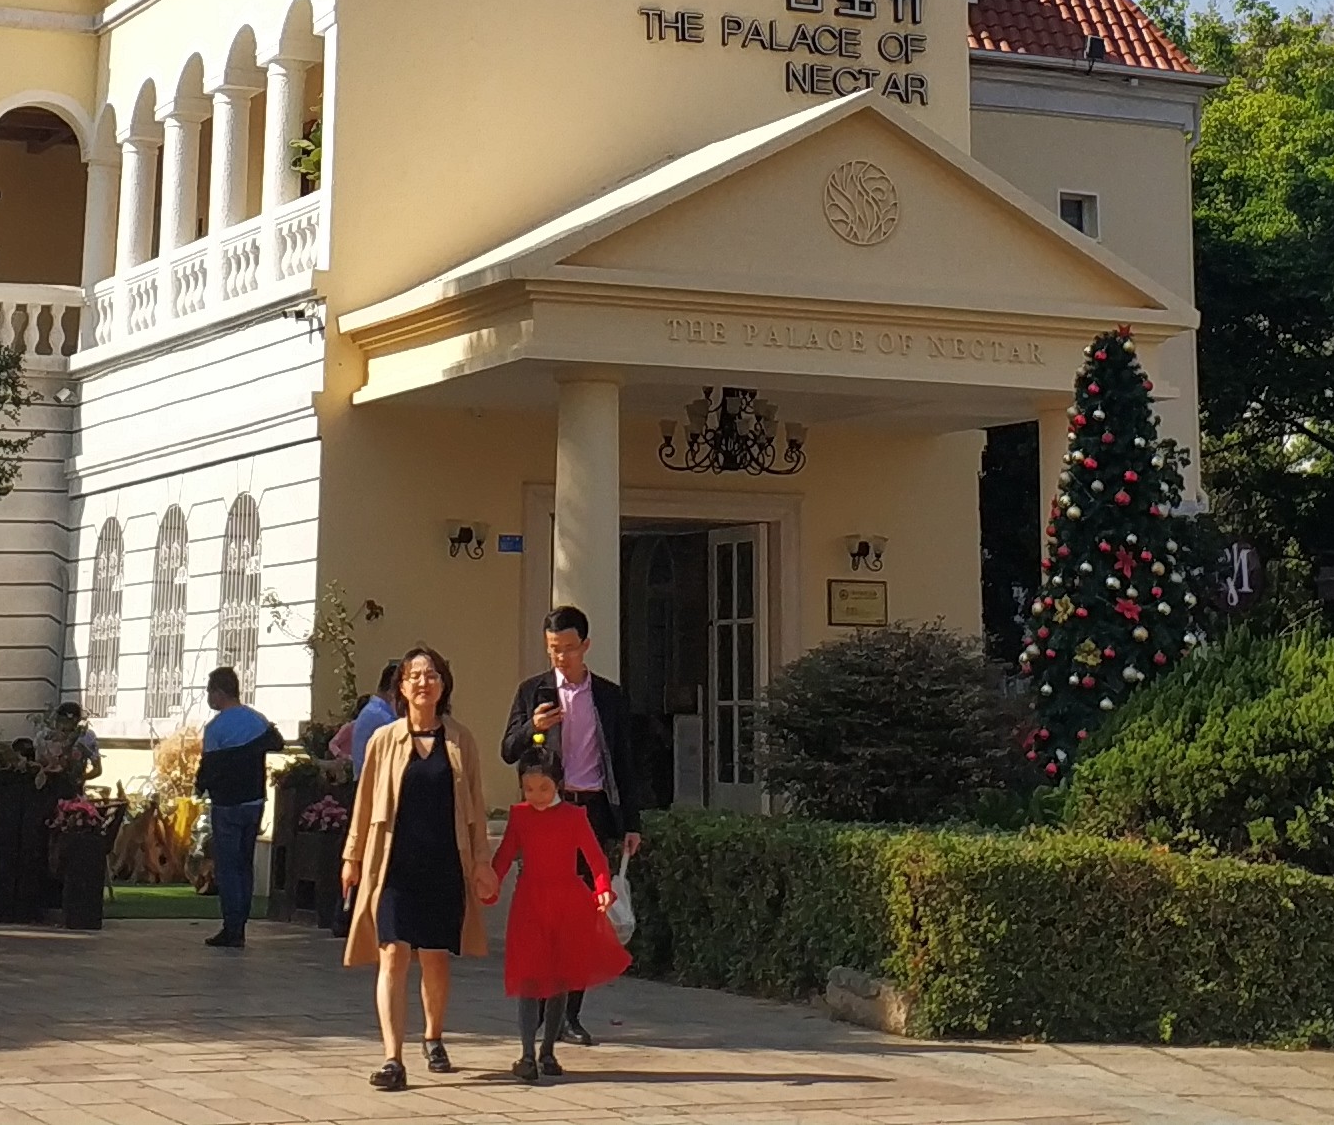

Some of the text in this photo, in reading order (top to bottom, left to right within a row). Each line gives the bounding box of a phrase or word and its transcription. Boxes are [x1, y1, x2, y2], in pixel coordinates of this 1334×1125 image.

[639, 7, 928, 65] THE PALACE OF
[785, 60, 929, 106] NECTAR
[666, 317, 1046, 367] THE PALACE OF NECTAR
